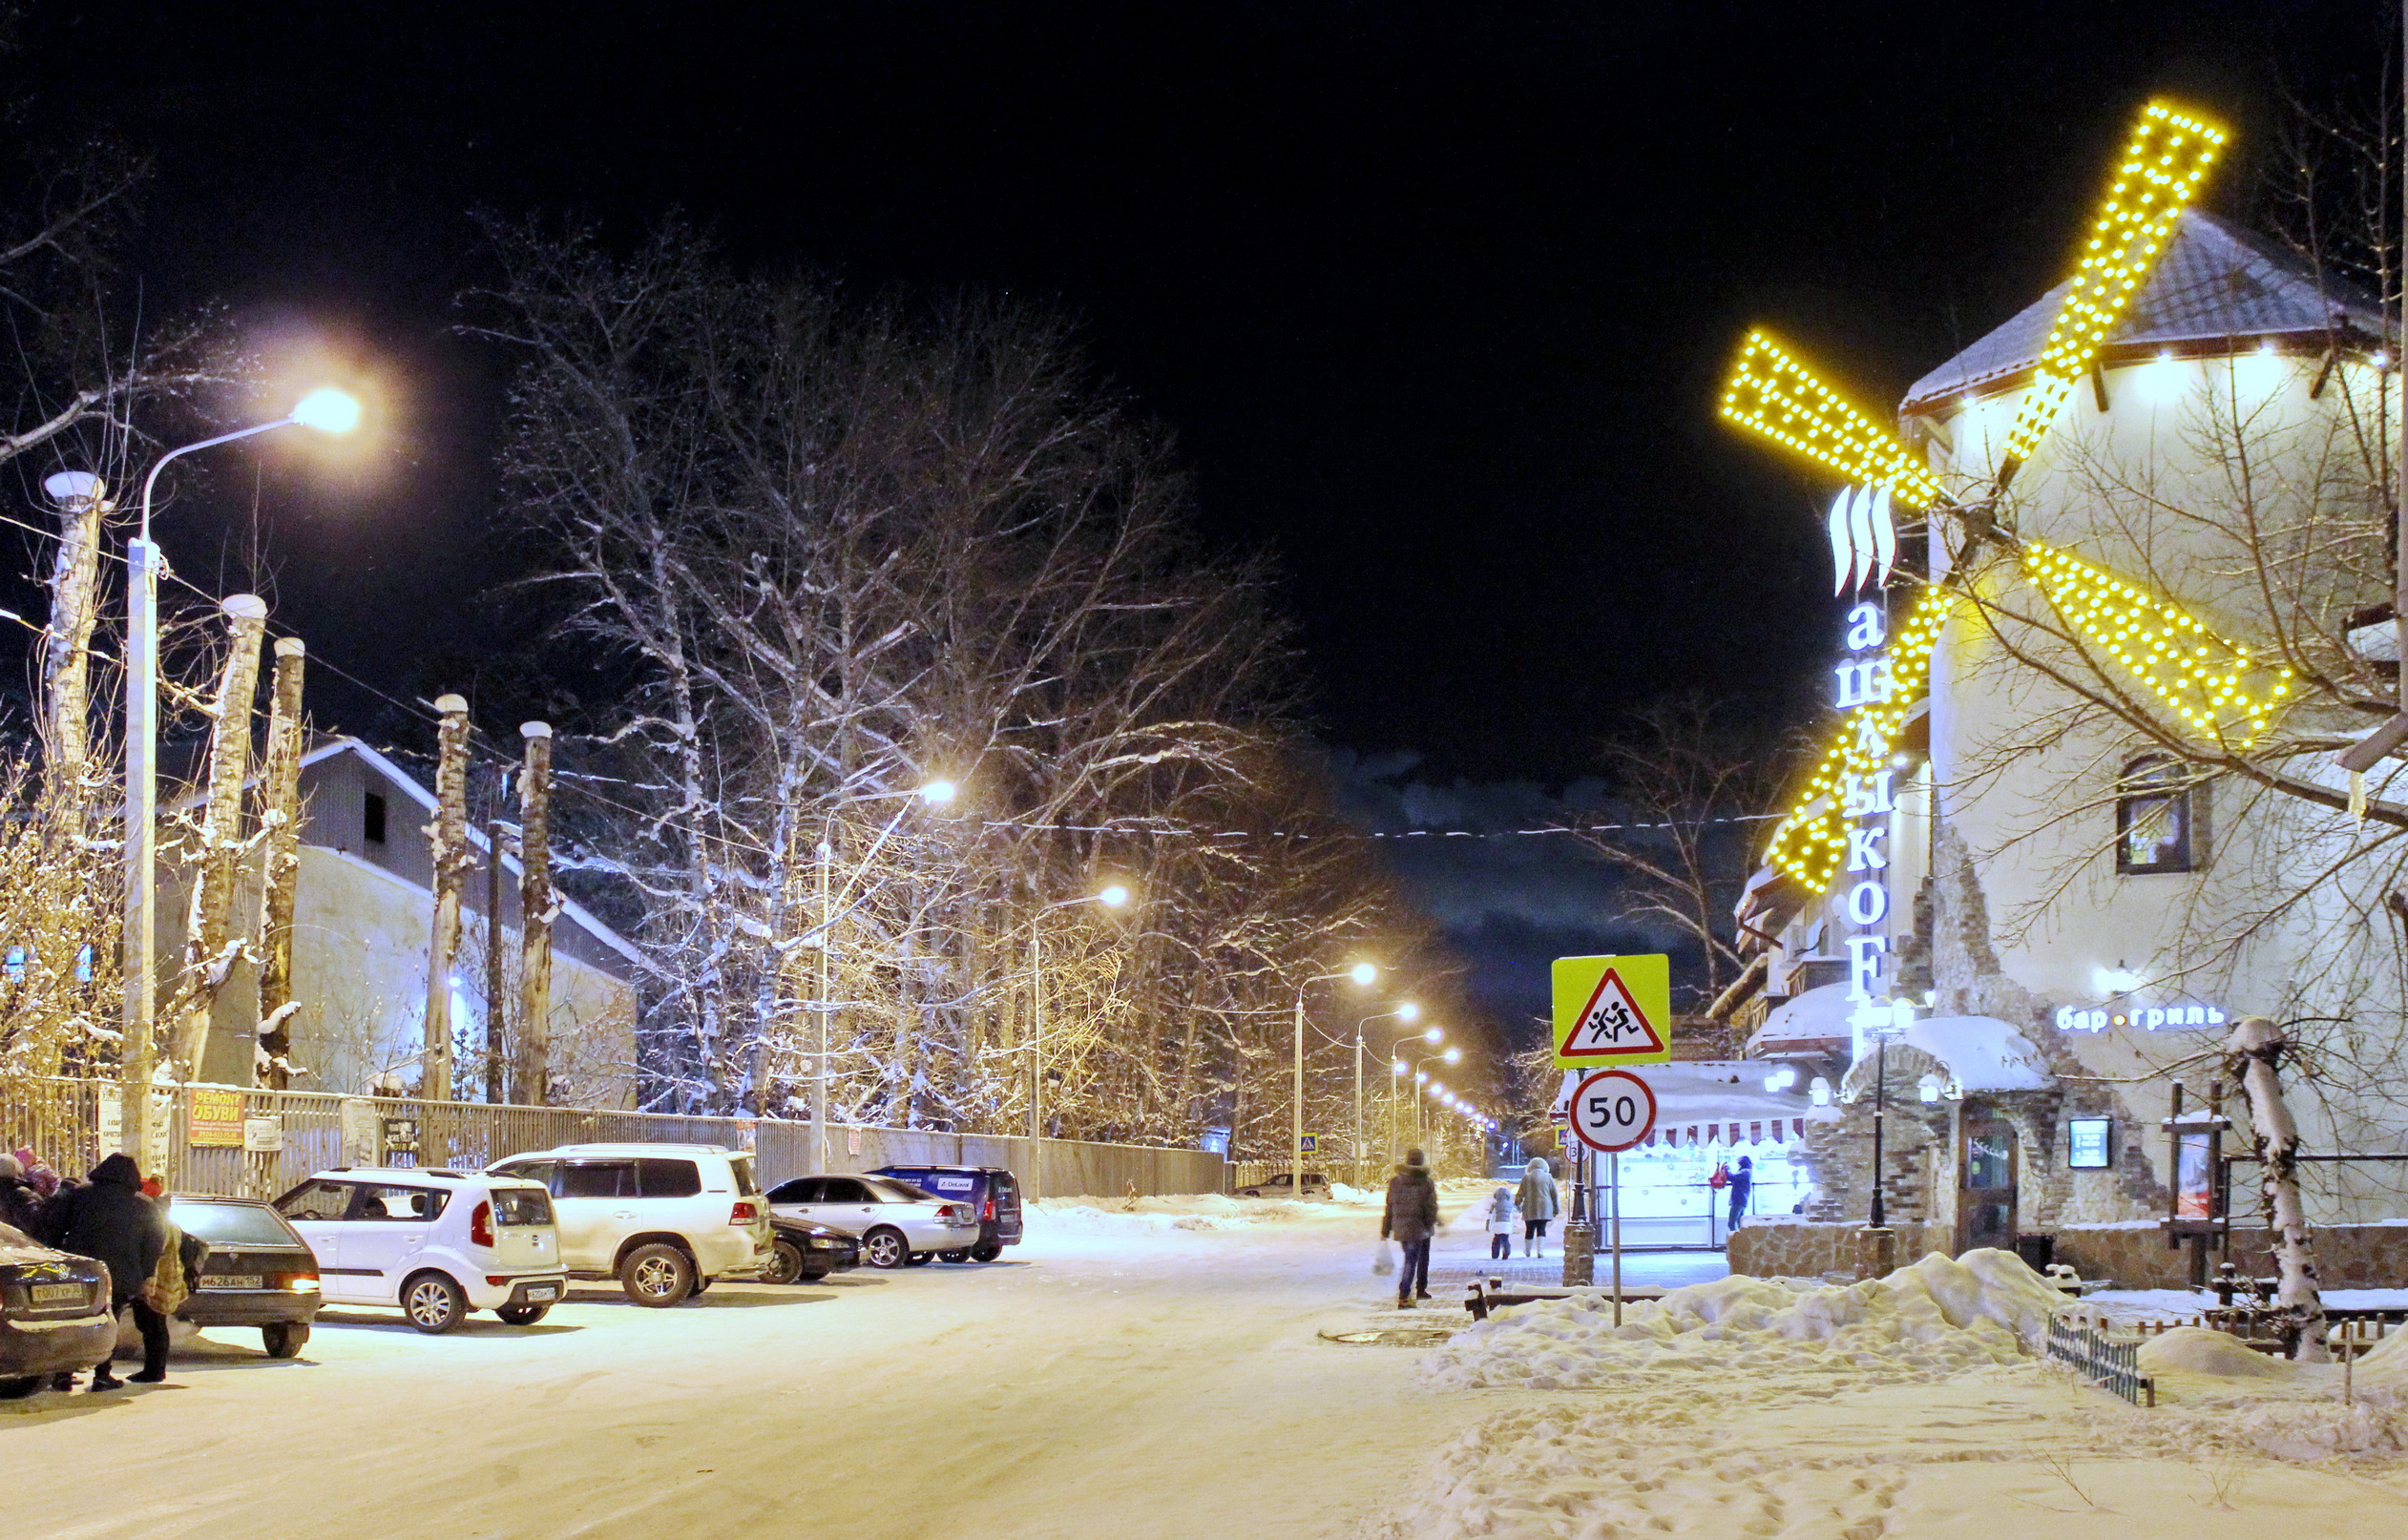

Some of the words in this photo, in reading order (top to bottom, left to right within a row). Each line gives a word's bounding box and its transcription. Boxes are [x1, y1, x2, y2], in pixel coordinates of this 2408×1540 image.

[195, 1092, 241, 1106] РЕМОНТ
[192, 1104, 240, 1121] ОБУВИ
[1589, 1095, 1636, 1128] 50
